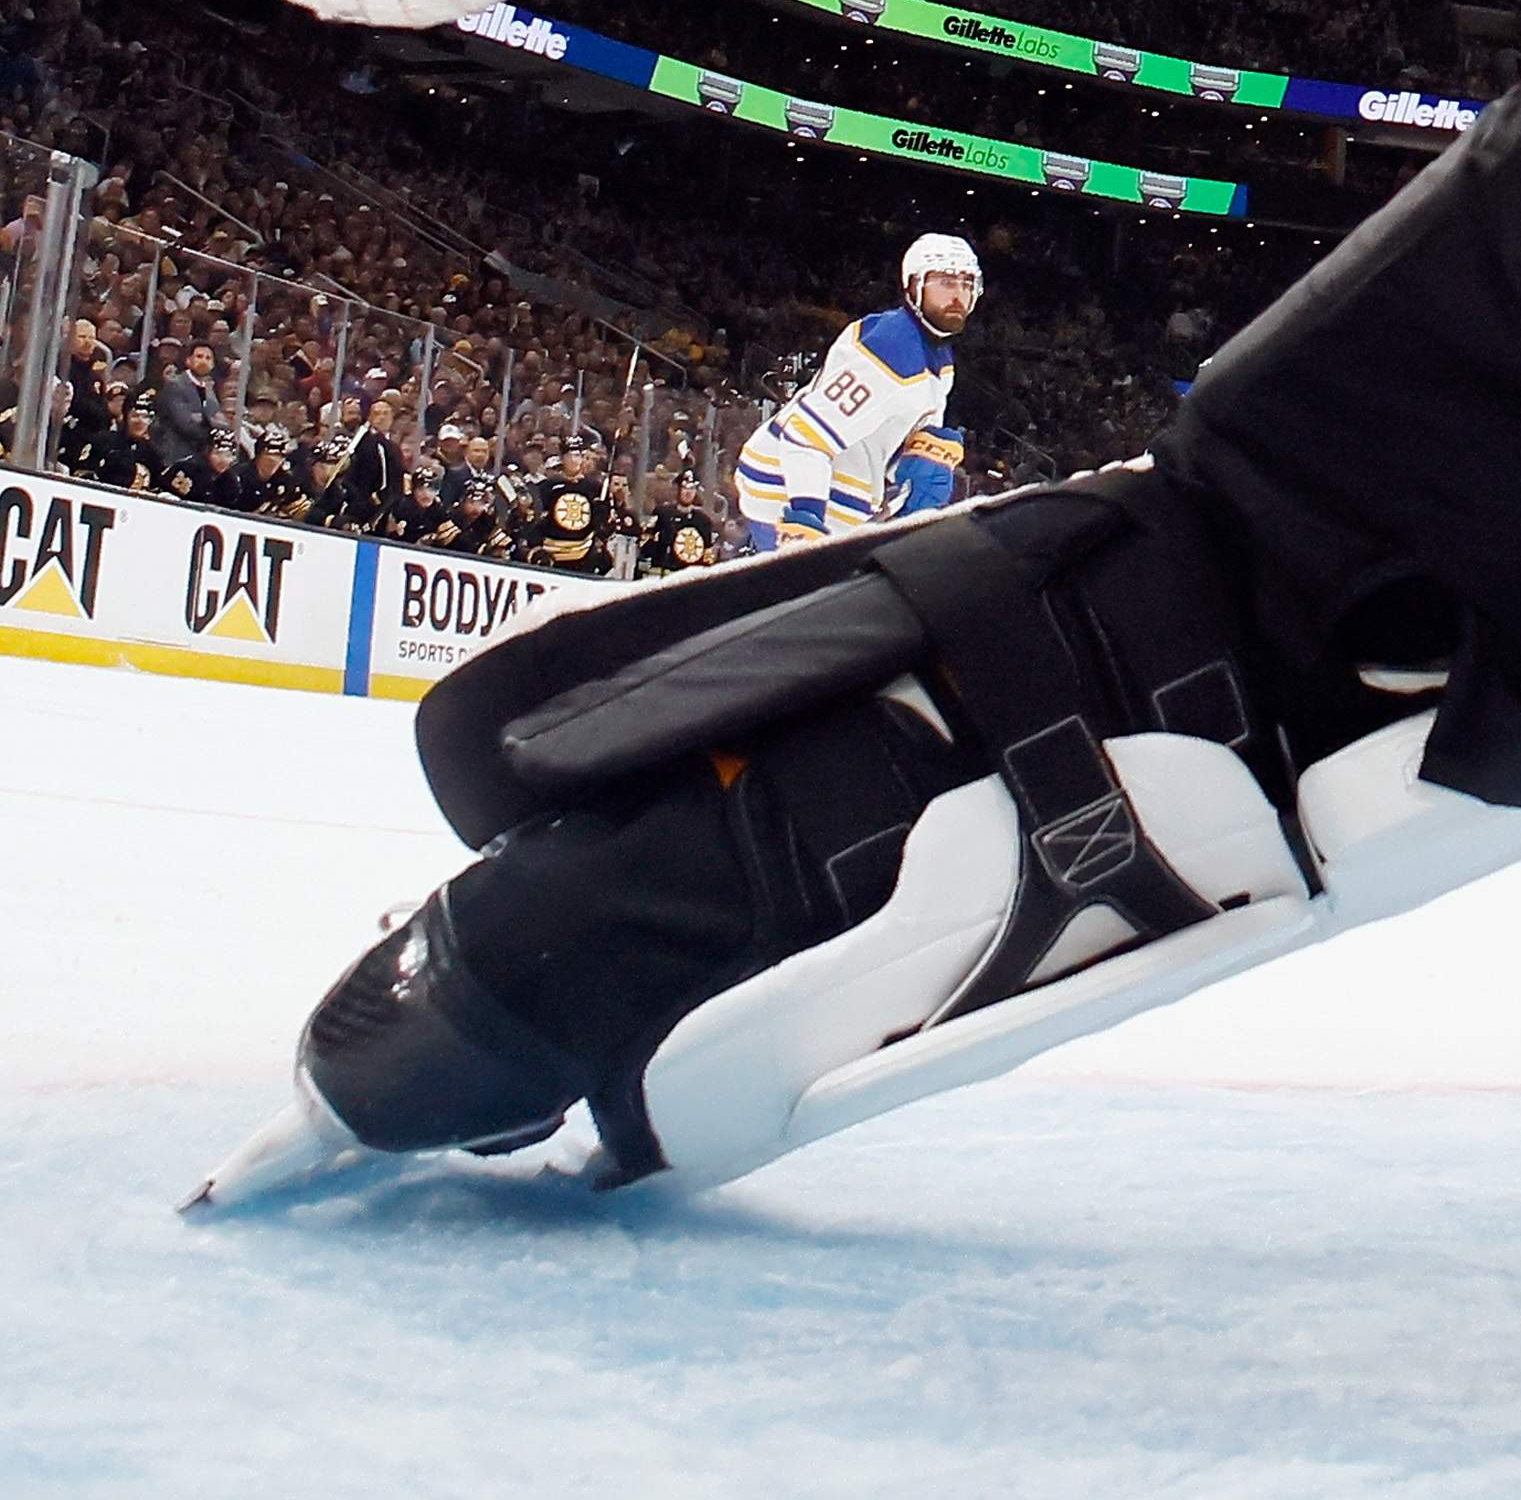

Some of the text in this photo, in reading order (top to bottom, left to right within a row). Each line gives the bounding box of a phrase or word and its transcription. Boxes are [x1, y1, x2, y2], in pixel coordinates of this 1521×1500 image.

[457, 2, 570, 60] Gillette
[1358, 88, 1476, 133] Gillette
[822, 368, 874, 419] 89
[912, 439, 961, 465] CCM
[0, 485, 115, 621] CAT
[184, 523, 295, 645] CAT
[398, 640, 455, 664] SPORTS
